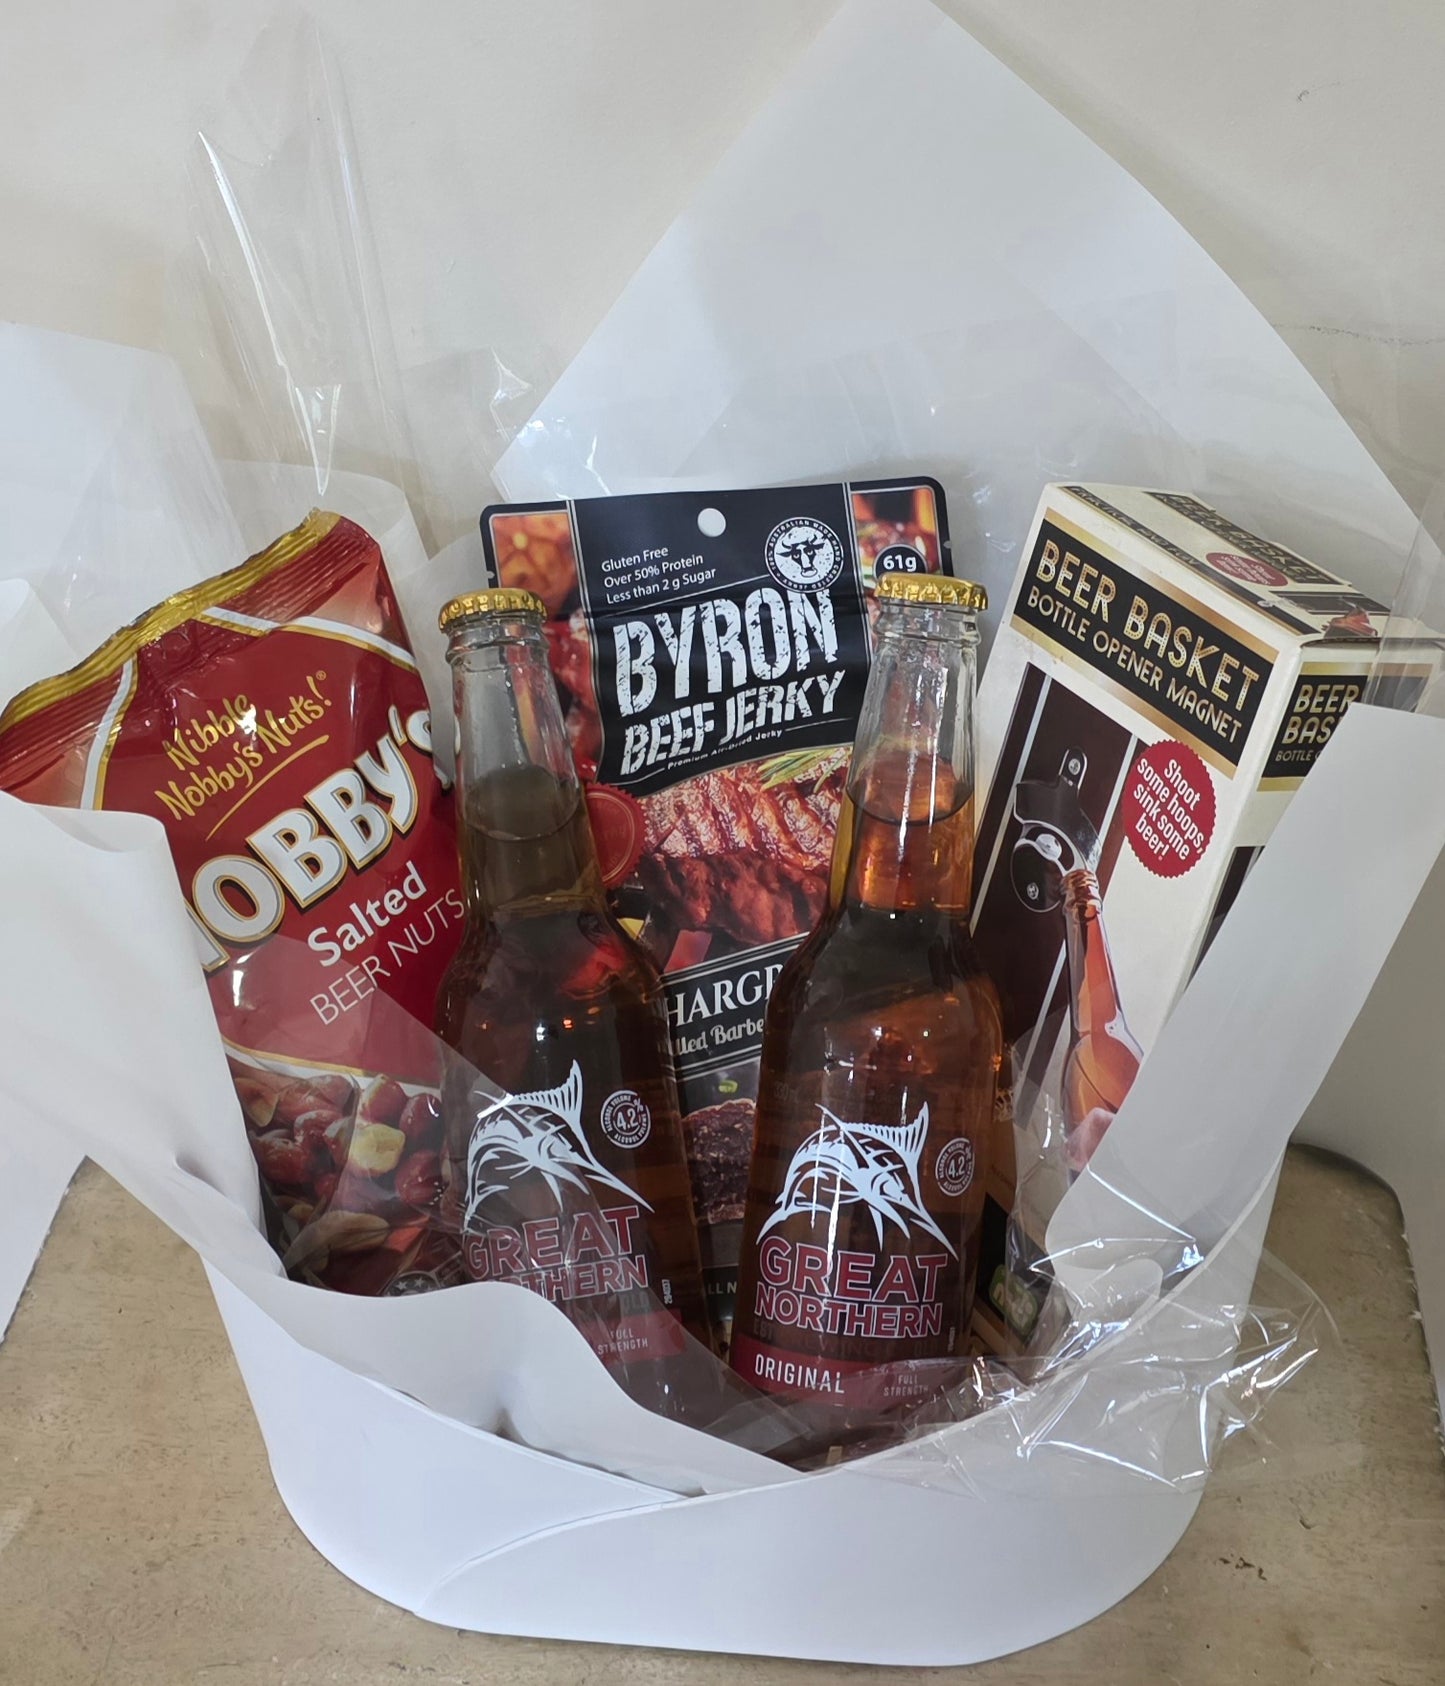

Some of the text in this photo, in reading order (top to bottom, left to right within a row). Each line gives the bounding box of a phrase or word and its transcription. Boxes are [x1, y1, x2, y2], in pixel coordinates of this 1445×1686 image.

[601, 547, 669, 572] Gluten Free
[604, 554, 704, 588] Over 50% Protein
[883, 554, 917, 572] 61g
[606, 568, 717, 605] Less than 2 g Sugar
[1036, 539, 1260, 712] BEER BASKET
[612, 587, 839, 718] BYRON
[1027, 585, 1242, 744] BOTTLE OPENER MAGNET
[620, 669, 846, 776] BEEF JERKY
[1293, 684, 1360, 713] BEER
[162, 694, 253, 771] Nibble
[667, 753, 709, 770] Premium
[755, 729, 782, 741] Jerky
[1275, 749, 1314, 762] BOTTLE
[1281, 715, 1337, 744] BAS
[154, 741, 263, 821] Nobby's
[1137, 758, 1205, 854] some hoops,
[1164, 759, 1201, 811] Shoot
[1133, 783, 1190, 861] sink some
[1135, 812, 1170, 861] beer!
[307, 861, 428, 967] Salted
[310, 888, 465, 1025] BEER NUTS
[462, 1205, 640, 1281] GREAT
[503, 1255, 648, 1302] THERN
[759, 1235, 948, 1304] GREAT
[610, 1328, 634, 1340] FULL
[754, 1281, 943, 1338] NORTHERN
[597, 1337, 648, 1355] STRENGTH
[755, 1353, 845, 1394] ORIGINAL
